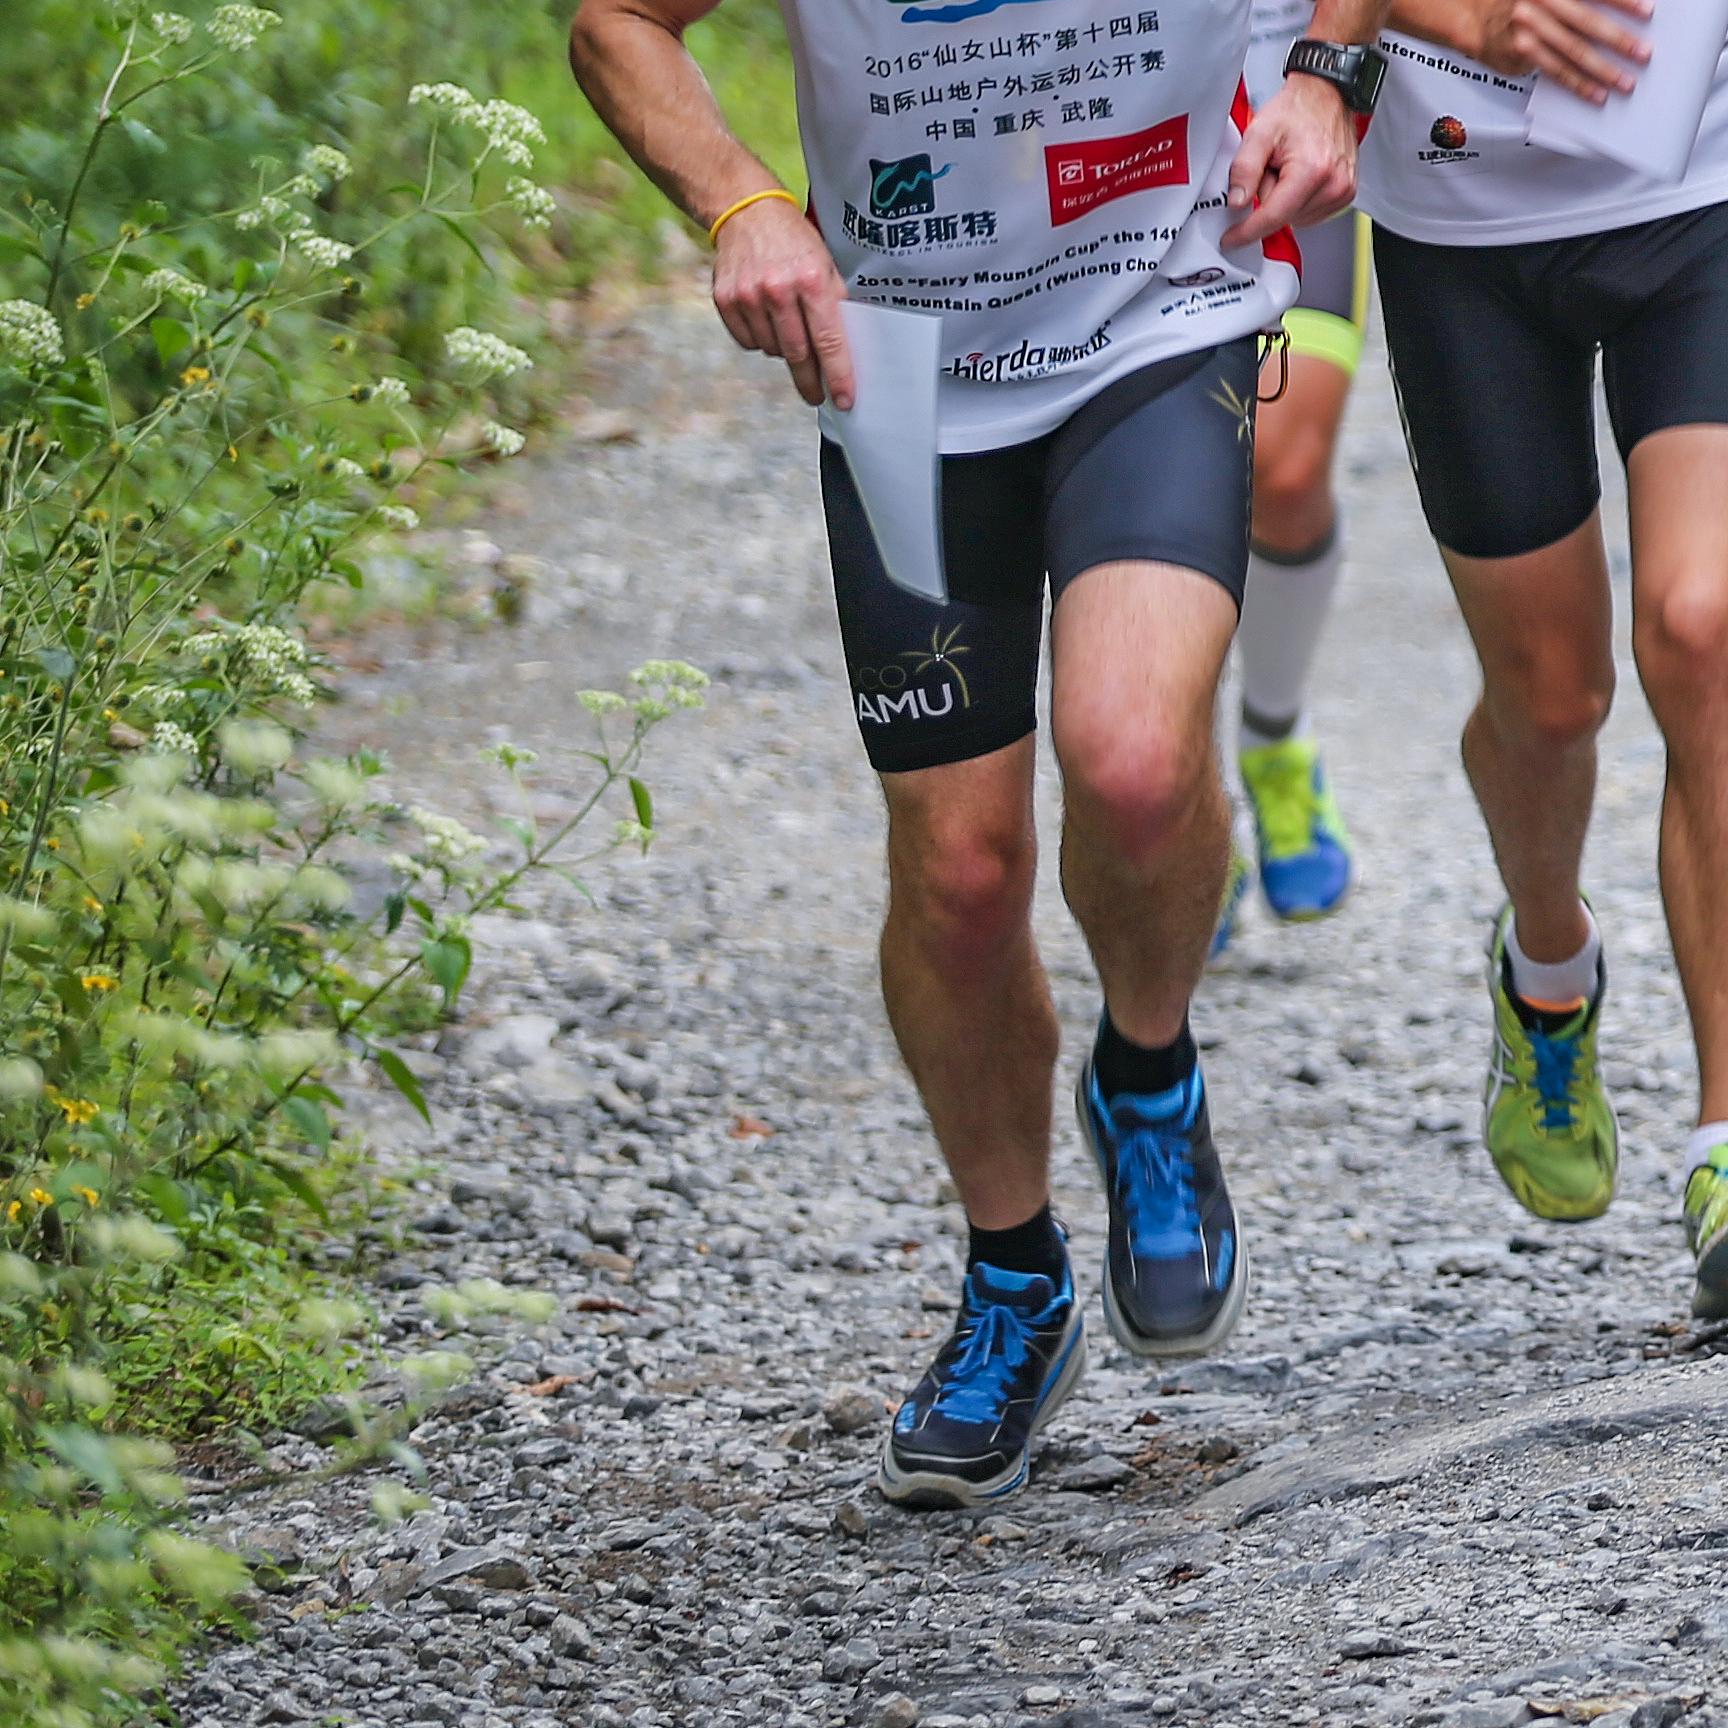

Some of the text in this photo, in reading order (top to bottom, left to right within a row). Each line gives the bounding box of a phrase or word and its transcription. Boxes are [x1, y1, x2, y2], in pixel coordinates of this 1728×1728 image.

[1378, 36, 1488, 83] International
[856, 274, 904, 287] 2016
[974, 253, 1061, 284] Mountain
[1113, 230, 1146, 244] the
[1150, 227, 1184, 242] 14t
[892, 296, 983, 312] Mountain
[987, 282, 1042, 308] Quest
